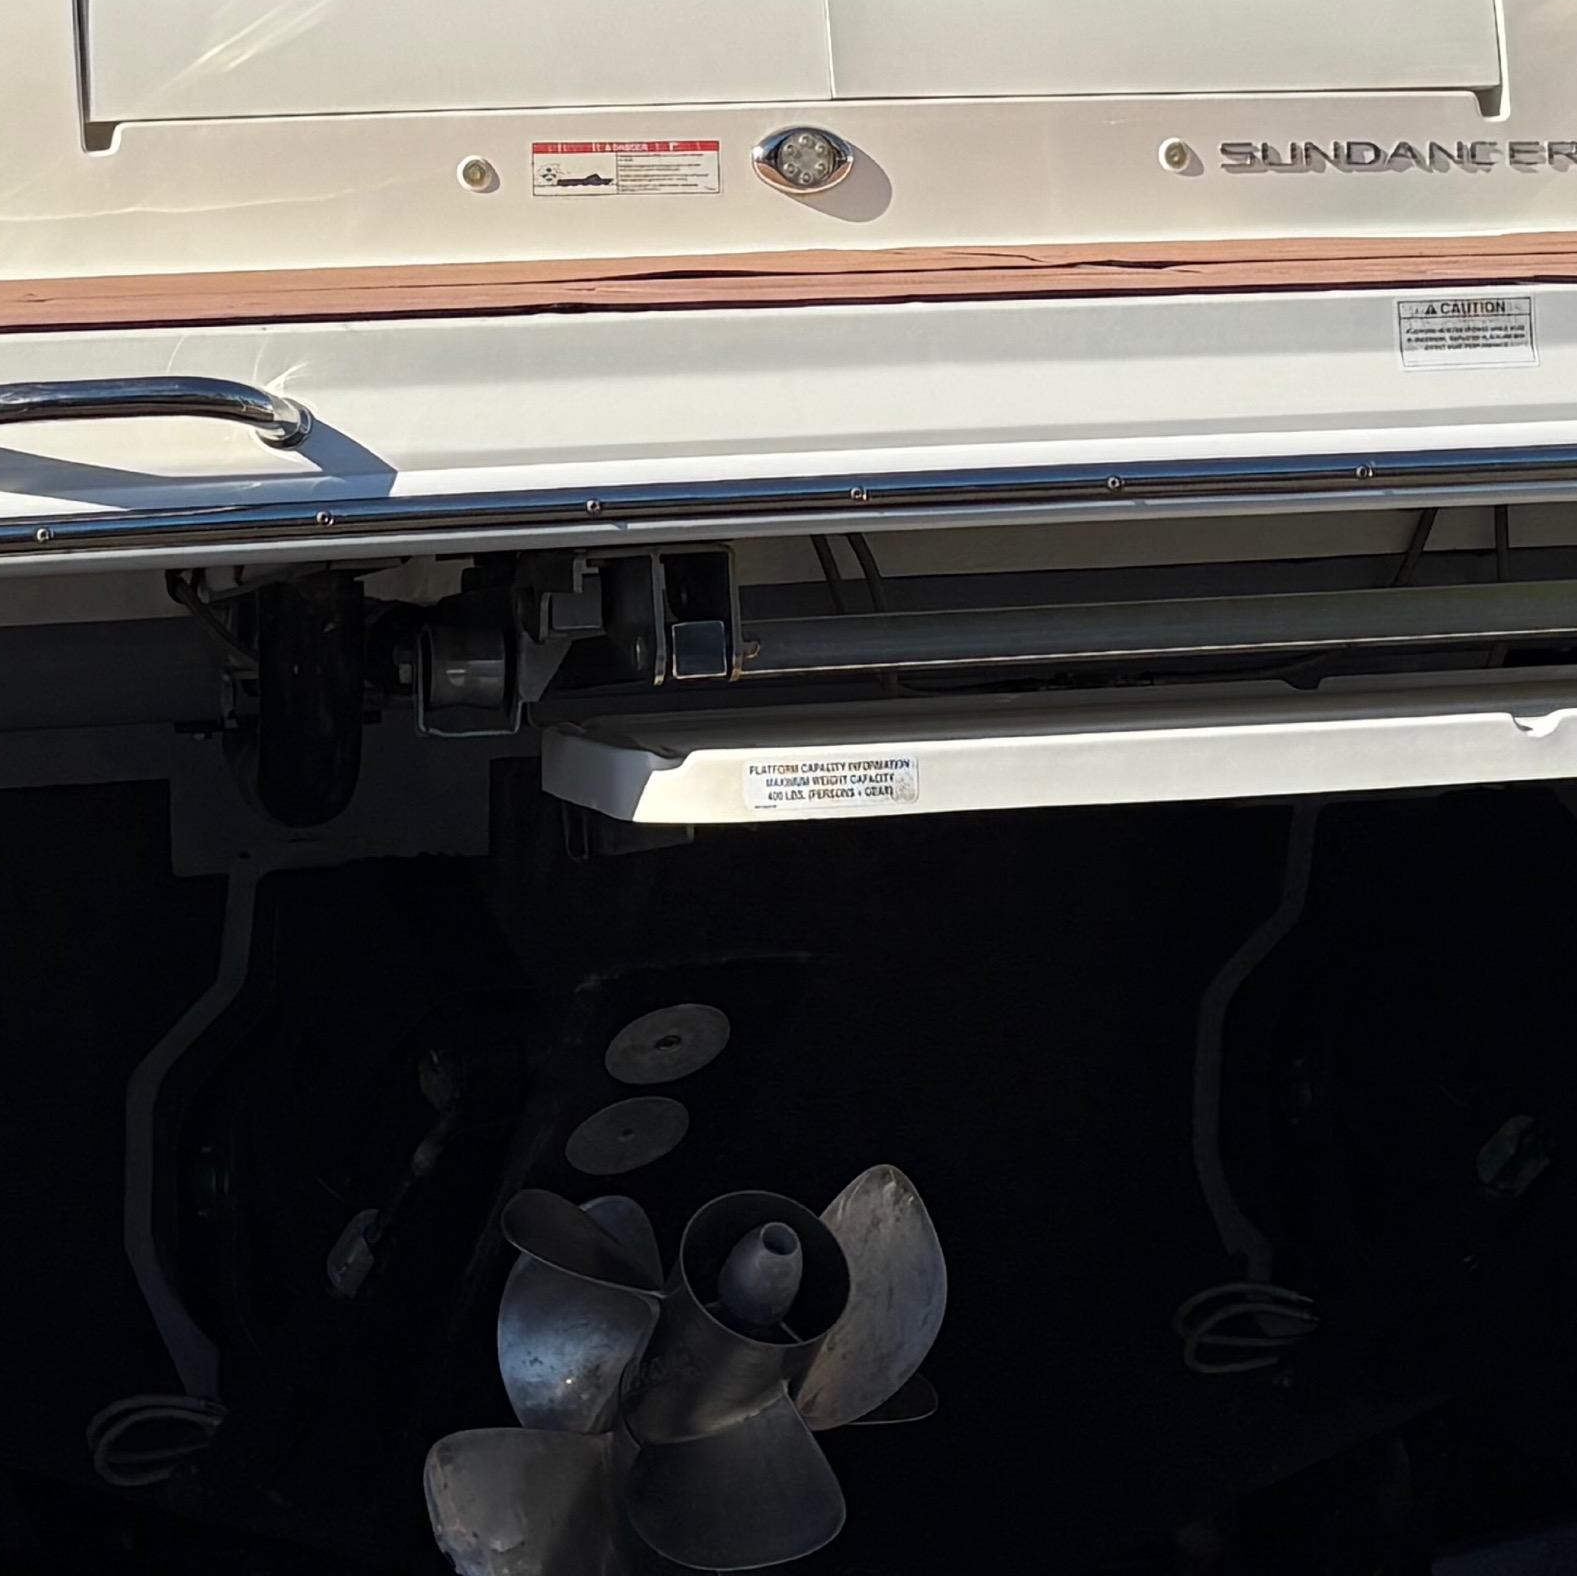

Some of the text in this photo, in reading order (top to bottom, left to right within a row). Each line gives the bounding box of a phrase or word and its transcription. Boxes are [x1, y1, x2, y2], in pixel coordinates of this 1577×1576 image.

[1440, 301, 1506, 314] CAUTION
[749, 759, 910, 776] PLATFORM CAPACITY INFORMATION
